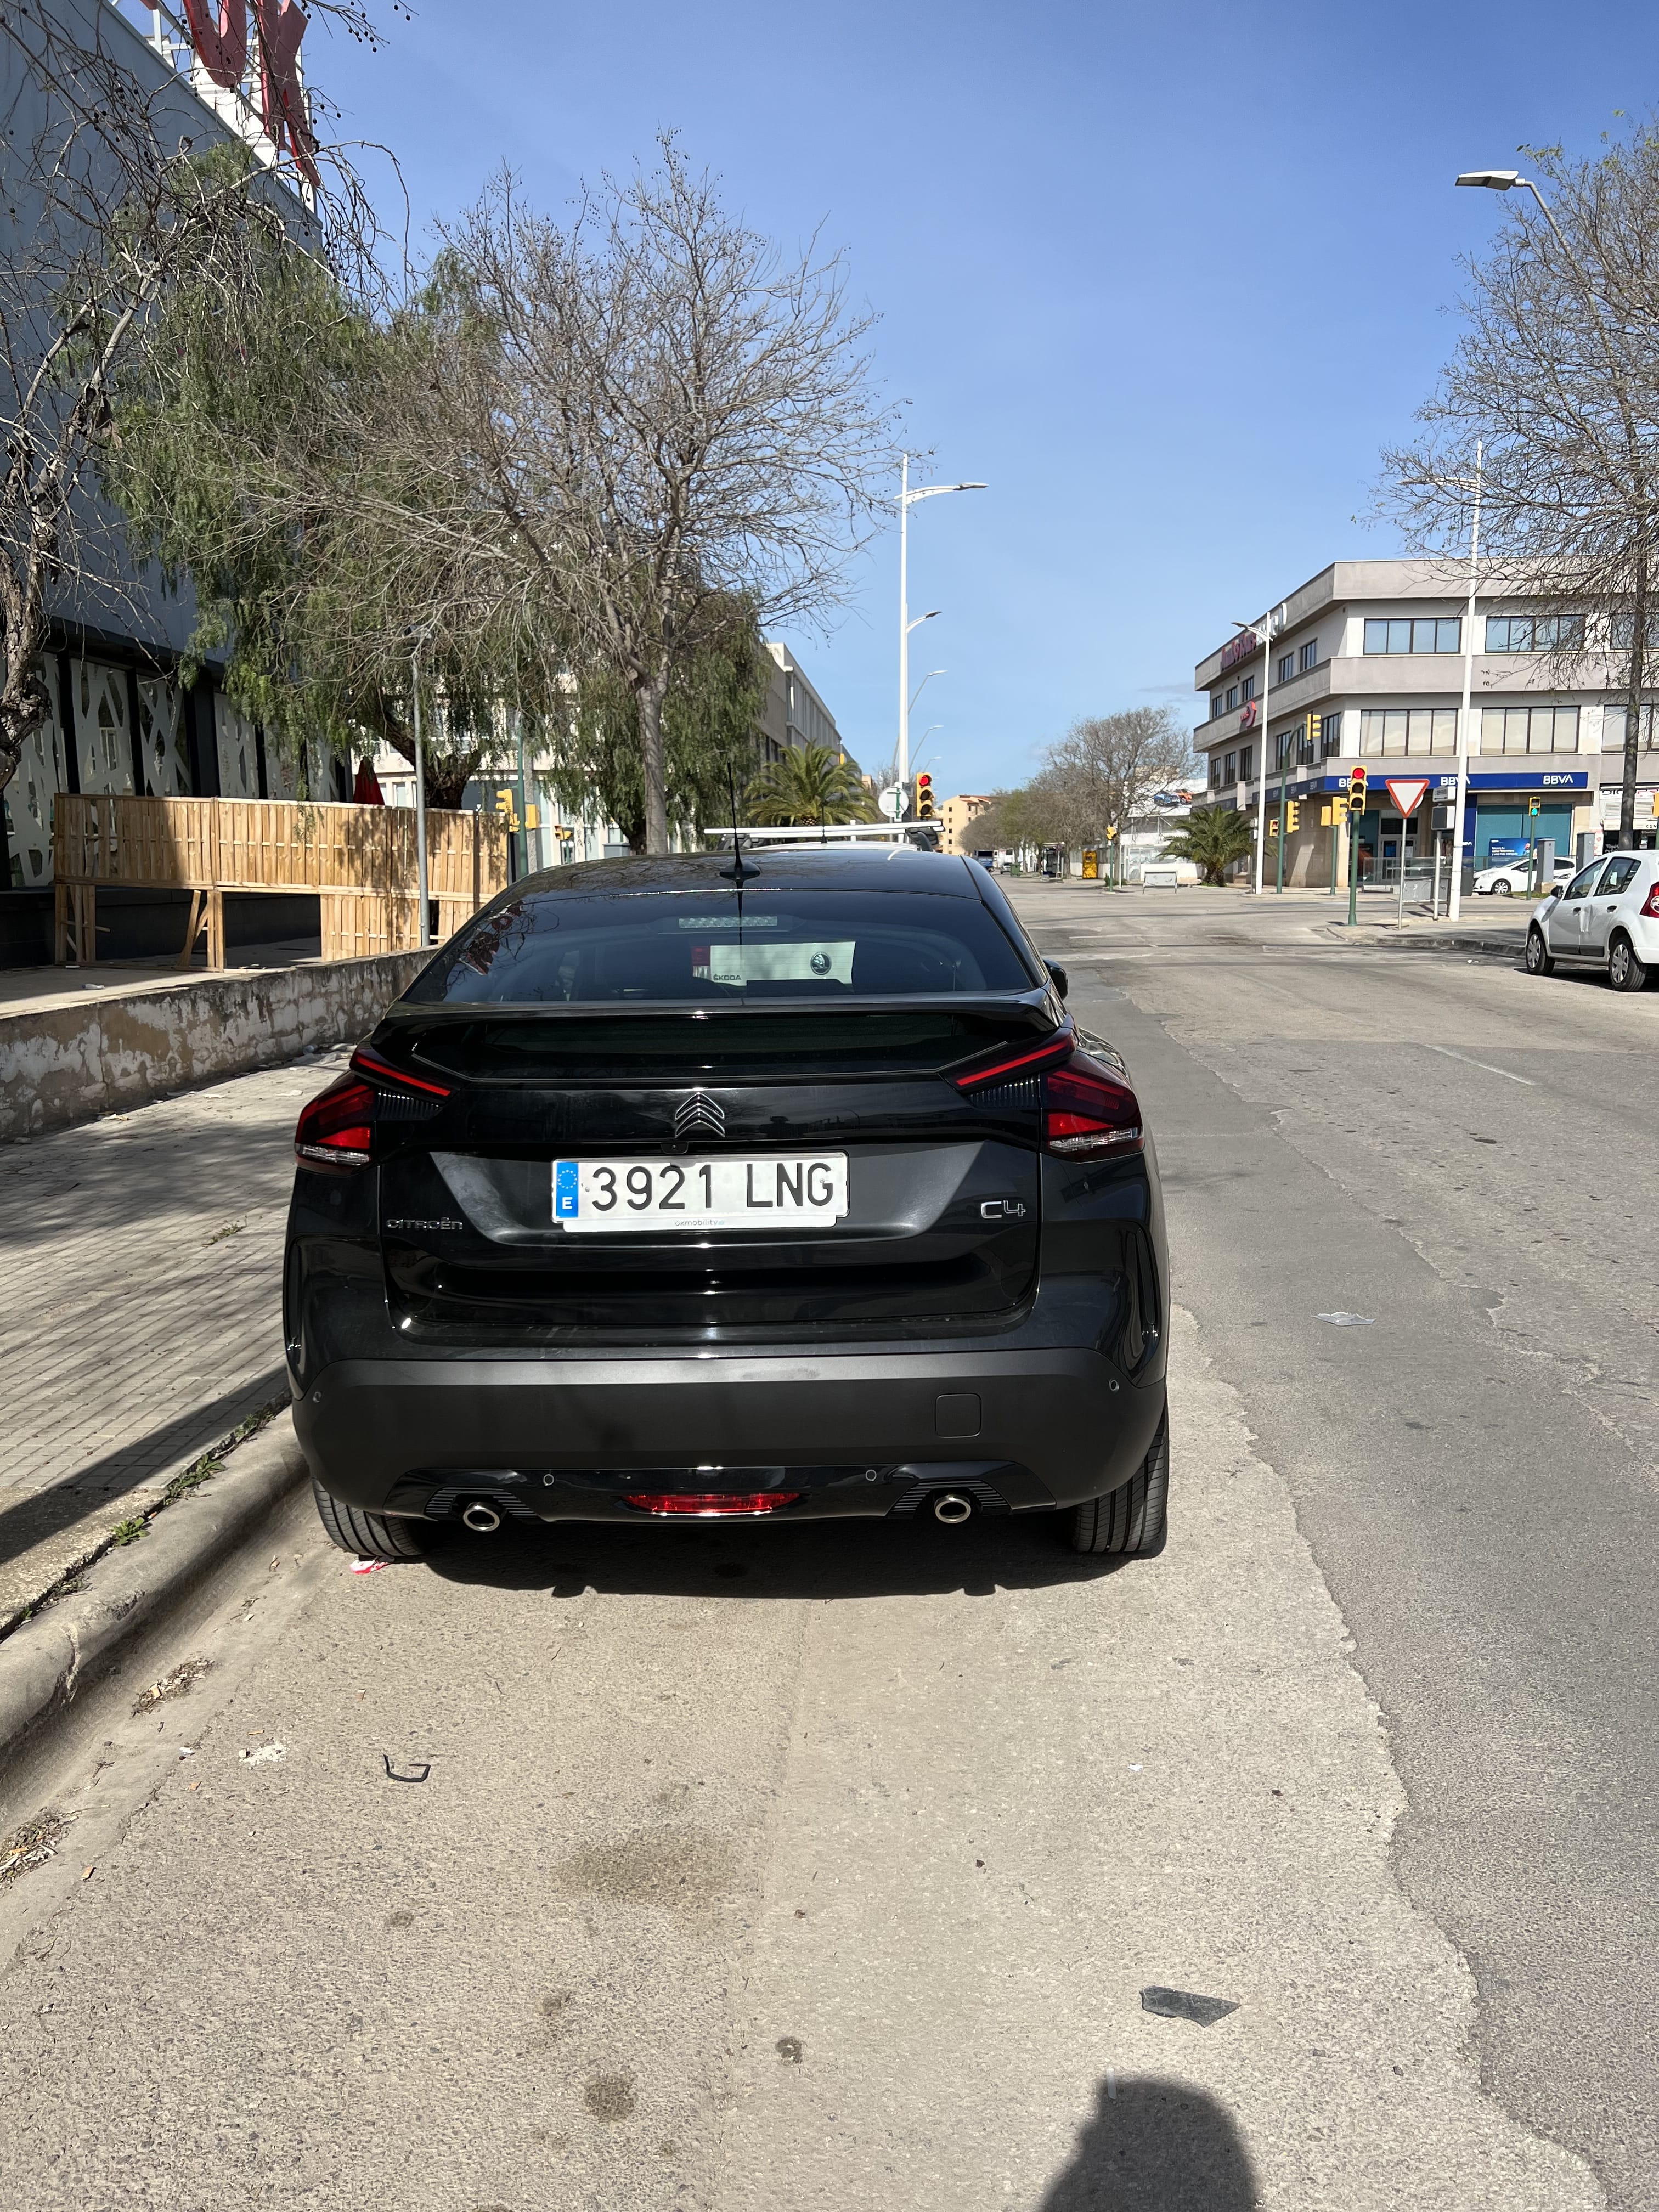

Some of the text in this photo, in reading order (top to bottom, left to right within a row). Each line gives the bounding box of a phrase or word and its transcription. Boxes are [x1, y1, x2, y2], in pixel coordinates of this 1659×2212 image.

[1543, 775, 1574, 785] BBVA
[592, 1162, 833, 1211] 3921 LNG
[562, 1197, 573, 1210] E
[981, 1200, 1026, 1219] C4
